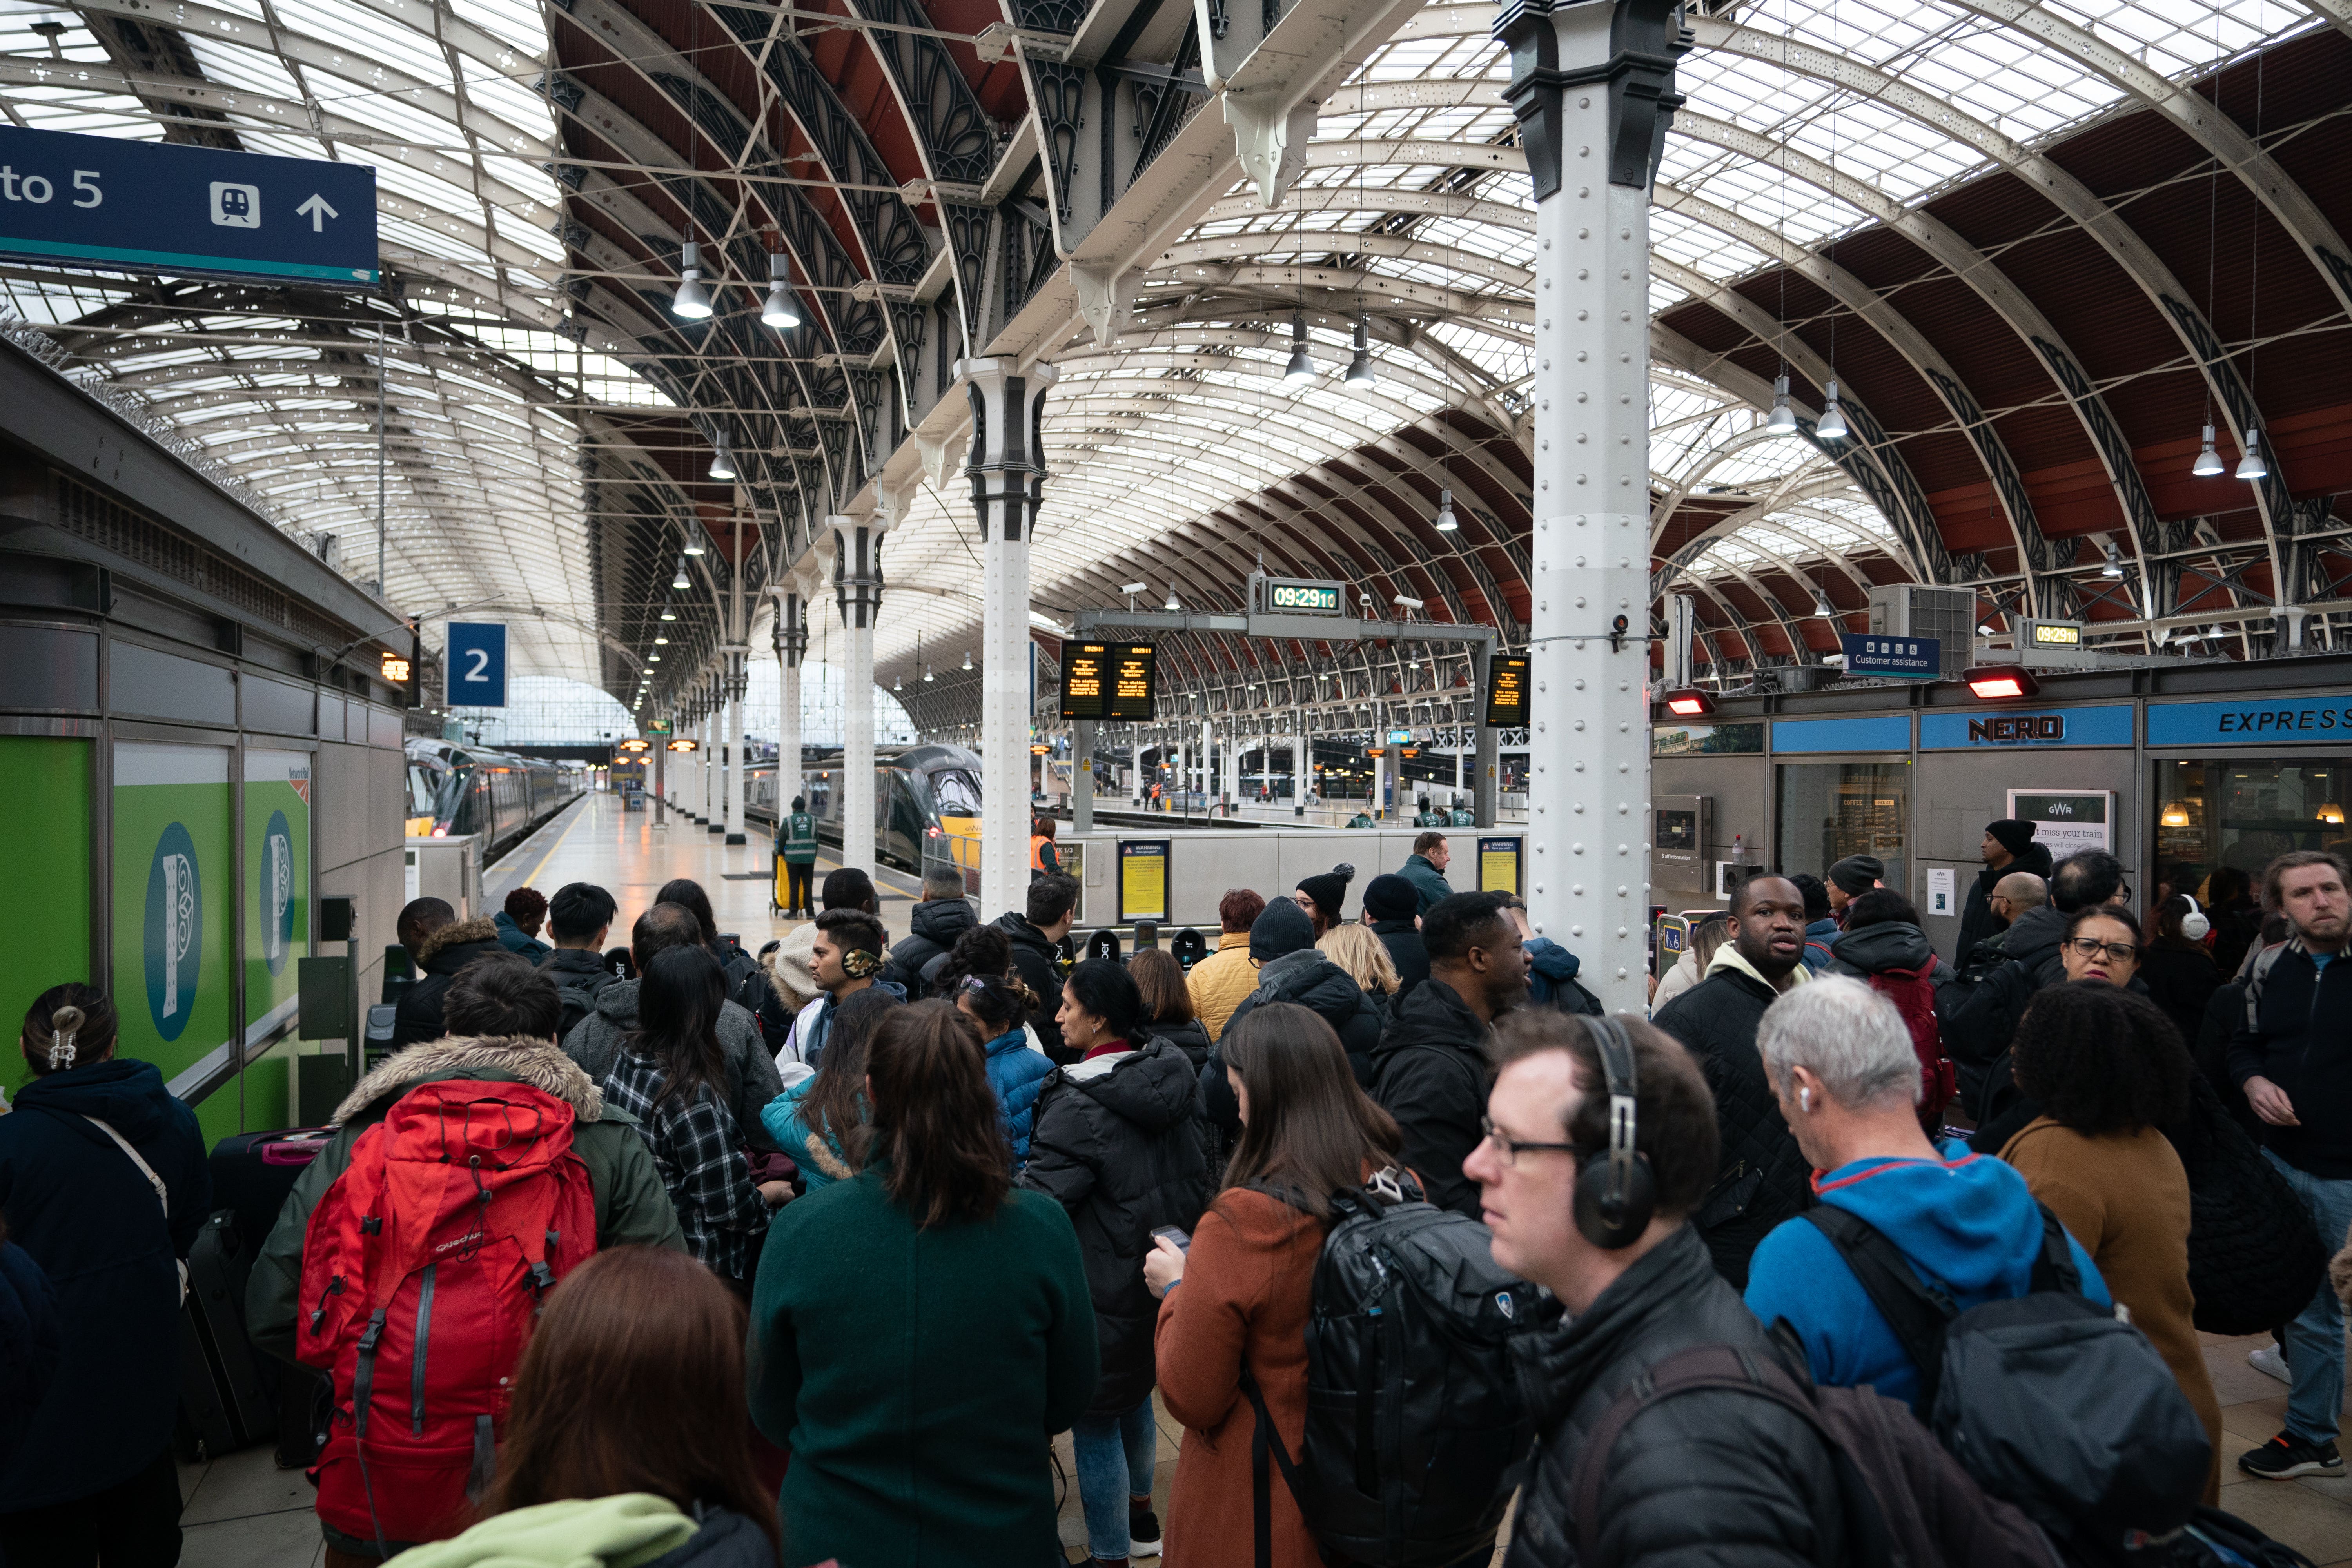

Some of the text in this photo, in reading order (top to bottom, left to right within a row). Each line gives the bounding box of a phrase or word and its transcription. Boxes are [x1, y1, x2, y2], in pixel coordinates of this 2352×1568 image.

[73, 170, 103, 209] 5
[465, 648, 489, 682] 2
[1855, 654, 1890, 665] Customer
[1892, 657, 1927, 667] assistance
[1969, 715, 2064, 741] NERO
[2049, 802, 2072, 816] GWR
